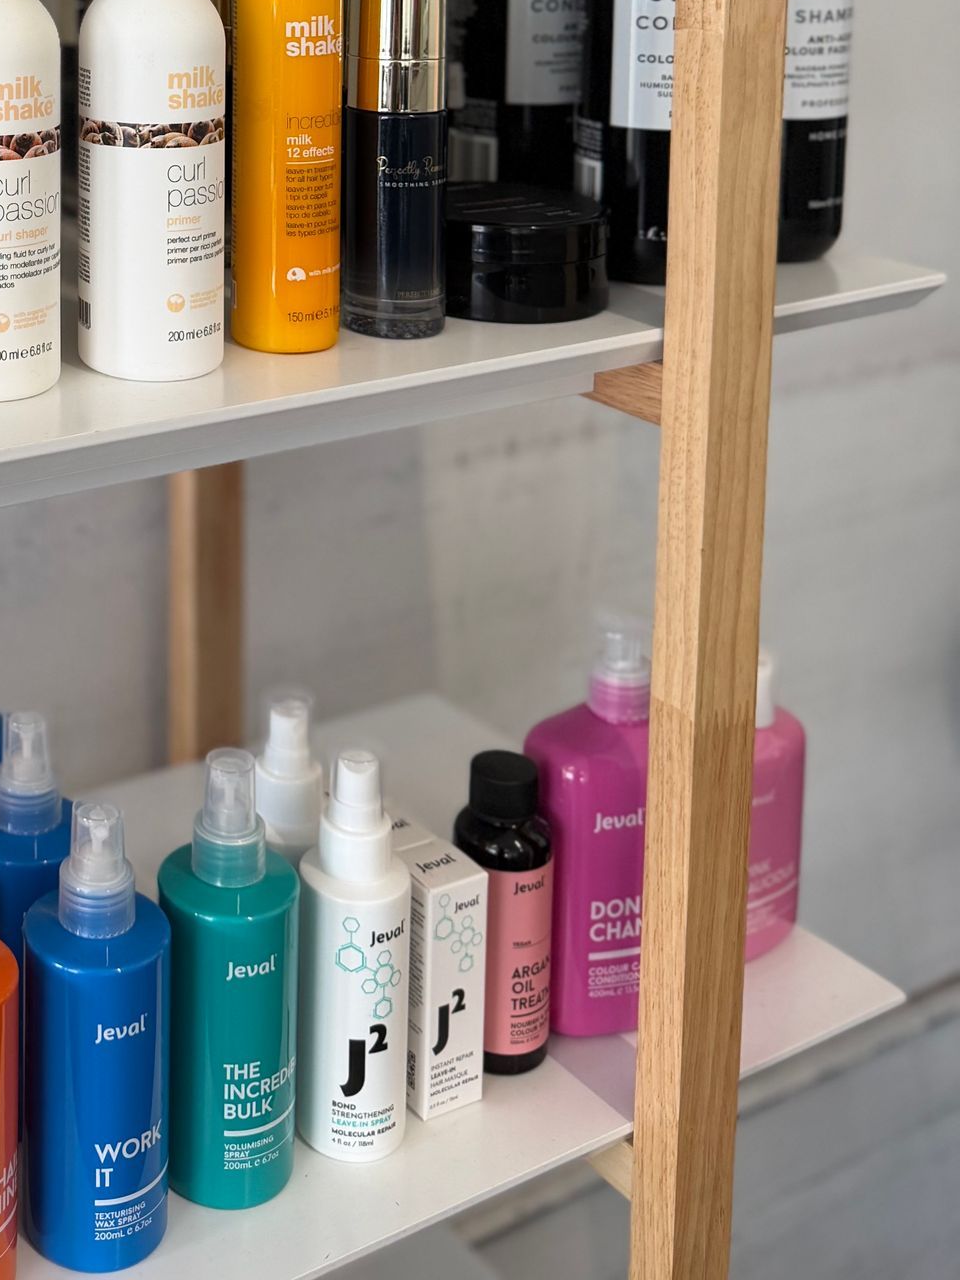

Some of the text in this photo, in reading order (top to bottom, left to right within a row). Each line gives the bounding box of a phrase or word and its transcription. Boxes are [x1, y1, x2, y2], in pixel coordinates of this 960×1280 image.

[286, 15, 335, 38] milk
[167, 65, 216, 90] milk
[167, 85, 224, 110] shake
[286, 133, 313, 146] milk
[287, 146, 335, 158] 12 effects
[167, 155, 206, 183] curl
[167, 215, 202, 228] primer
[593, 807, 644, 834] Jeval
[513, 875, 545, 896] Jeval
[454, 894, 481, 915] Jeval
[370, 919, 406, 948] Jeval
[226, 955, 276, 981] Jeval
[512, 979, 535, 995] OIL
[94, 1014, 146, 1045] Jeval
[223, 1060, 261, 1081] THE
[224, 1095, 274, 1120] BULK
[332, 1100, 357, 1111] BOND
[332, 1103, 395, 1120] STRENGTHENING
[331, 1121, 397, 1138] MOLECULAR REPAIR
[371, 1114, 392, 1126] SPRAY
[94, 1118, 162, 1164] WORK
[224, 1135, 274, 1152] VOLUMISING
[224, 1151, 251, 1159] SPRAY
[95, 1167, 114, 1188] IT
[95, 1200, 146, 1220] TEXTURISING
[95, 1213, 141, 1228] WAX SPRAY
[95, 1229, 125, 1241] 200mL
